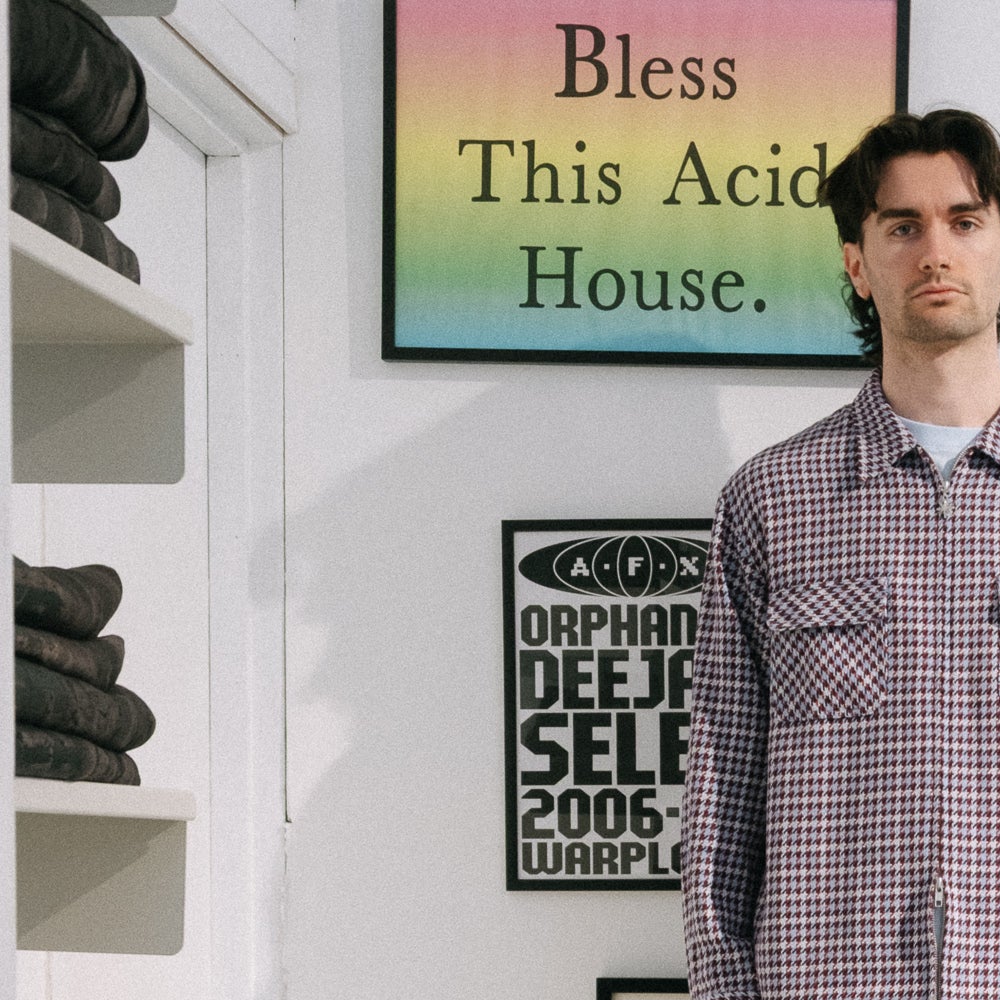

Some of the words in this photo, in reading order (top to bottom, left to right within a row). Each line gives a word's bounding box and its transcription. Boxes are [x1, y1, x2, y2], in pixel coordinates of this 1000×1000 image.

[555, 24, 737, 100] Bless
[458, 139, 622, 205] This
[662, 142, 832, 207] Acid
[519, 245, 766, 313] House.
